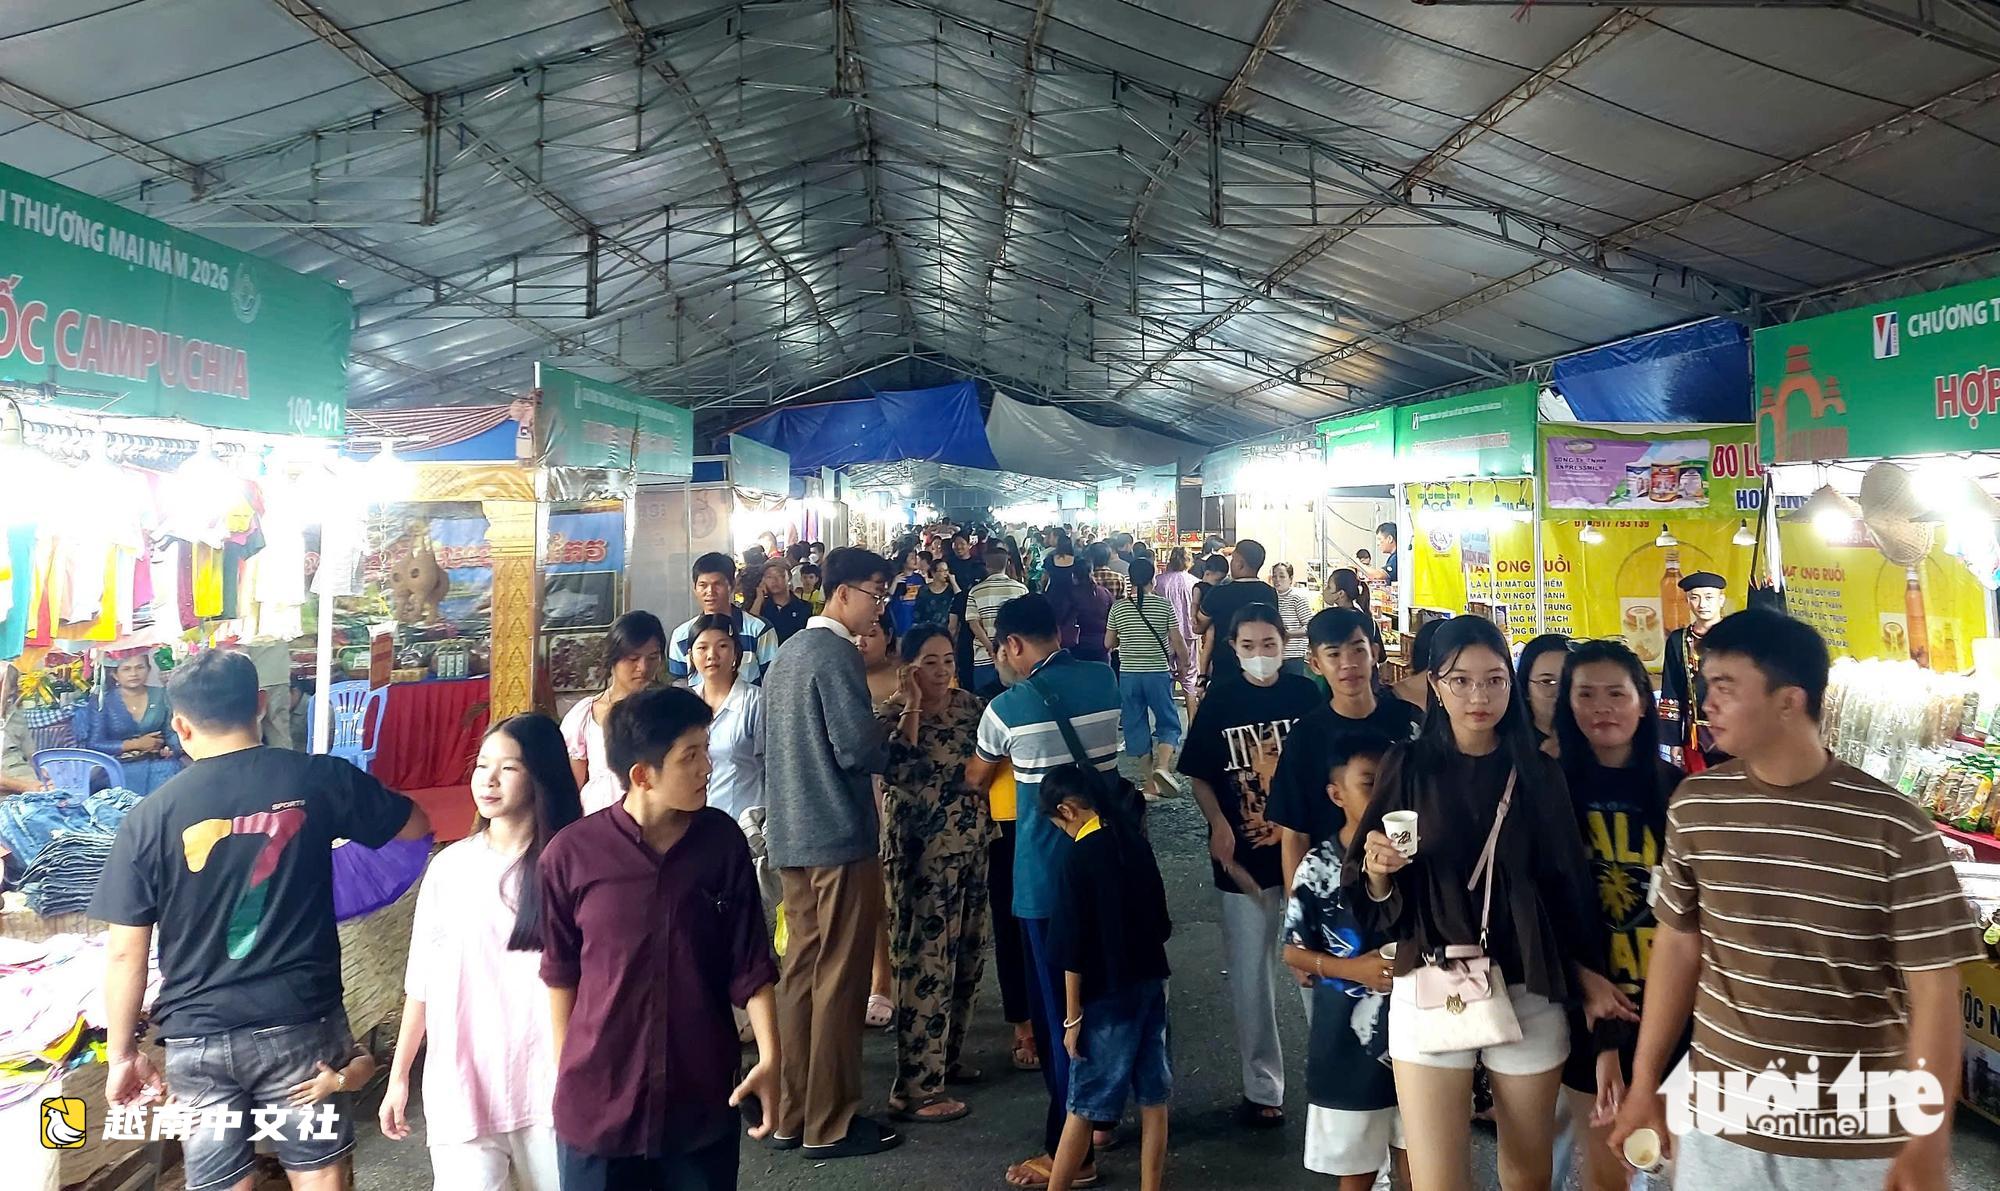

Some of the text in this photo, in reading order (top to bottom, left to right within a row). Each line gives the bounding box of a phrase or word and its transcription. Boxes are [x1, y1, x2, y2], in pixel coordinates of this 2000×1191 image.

[11, 191, 104, 253] THƯƠNG
[108, 226, 144, 271] MẠI
[148, 240, 189, 282] NĂM
[190, 255, 229, 292] 2026
[1907, 299, 1988, 338] CHƯƠNG
[54, 307, 250, 400] CAMPUCHIA
[286, 396, 340, 431] 100-101
[1935, 364, 2000, 430] HỢP
[1496, 559, 1532, 573] ONG
[1543, 553, 1572, 573] UỒI
[1959, 985, 1985, 1030] ỘC
